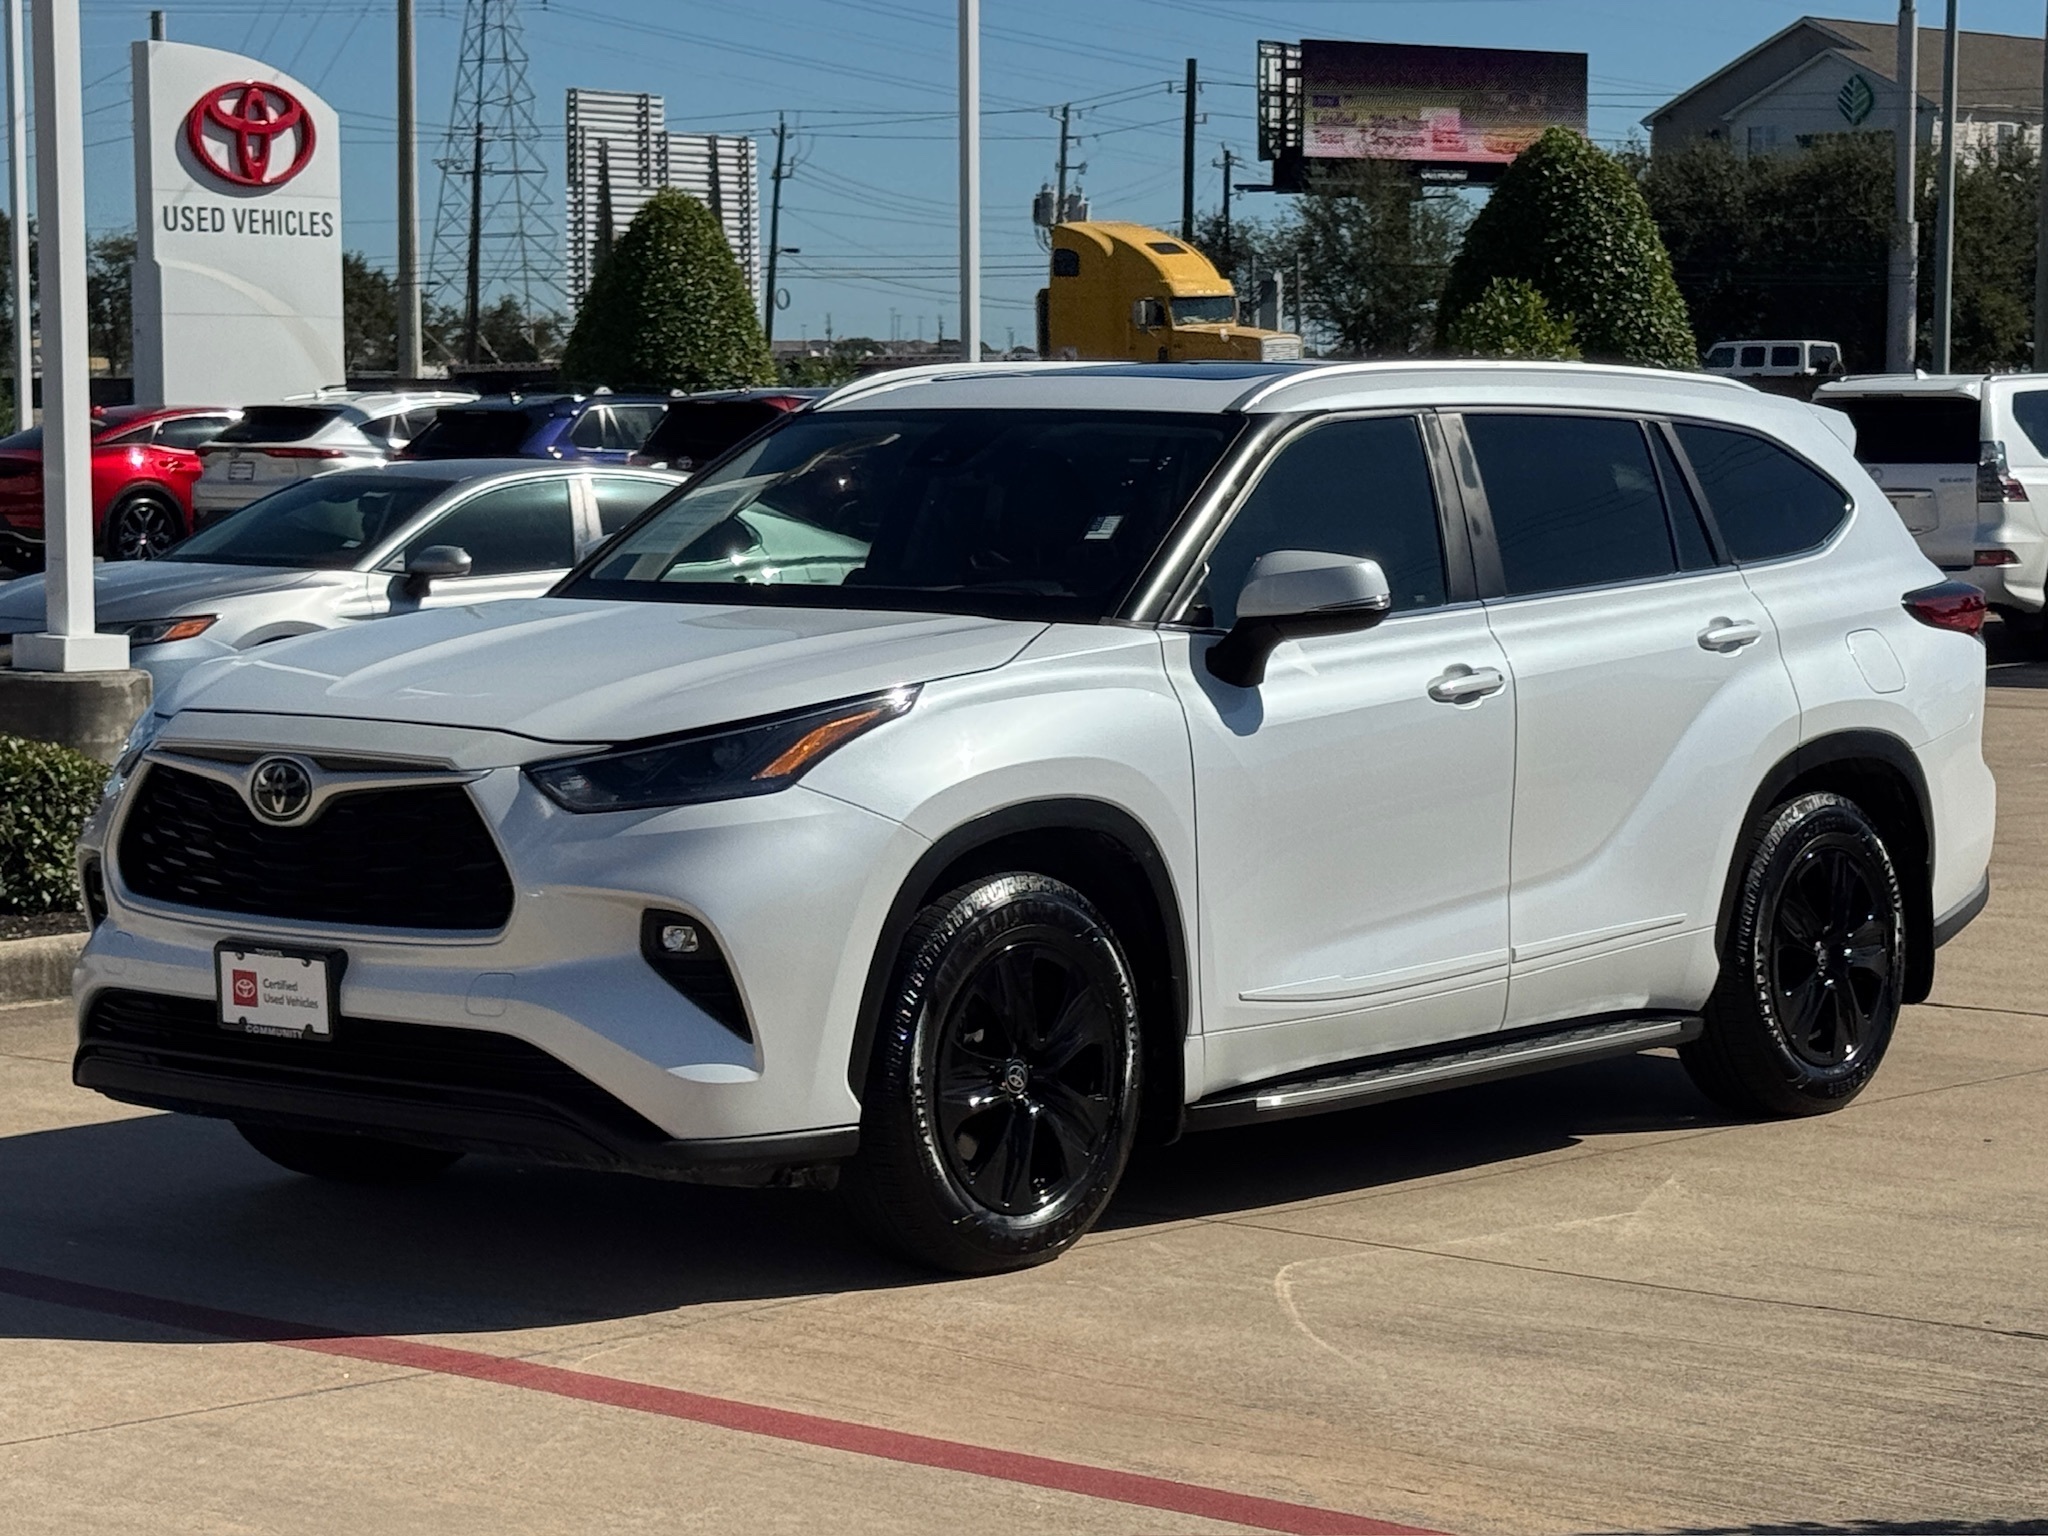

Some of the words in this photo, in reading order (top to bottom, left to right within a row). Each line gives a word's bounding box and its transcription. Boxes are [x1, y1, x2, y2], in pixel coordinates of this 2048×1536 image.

[163, 205, 226, 233] USED
[232, 207, 334, 238] VEHICLES
[262, 978, 298, 992] Certified
[263, 994, 285, 1005] Used
[286, 995, 319, 1009] Vehicles
[245, 1024, 303, 1039] COMMUNITY
